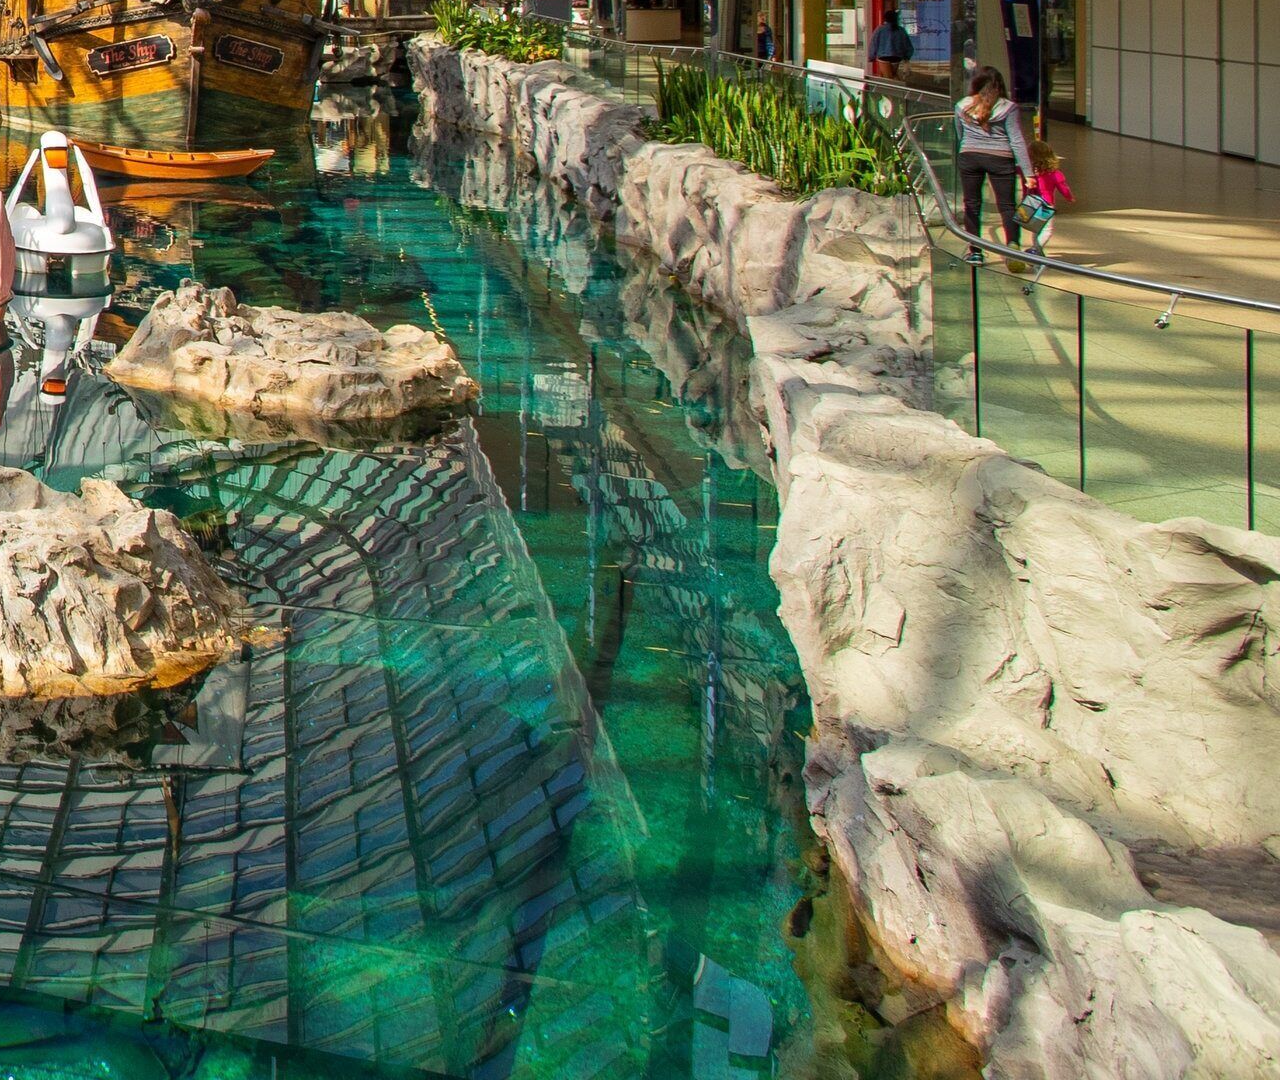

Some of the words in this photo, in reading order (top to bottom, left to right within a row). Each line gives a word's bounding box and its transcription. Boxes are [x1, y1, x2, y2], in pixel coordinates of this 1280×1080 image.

[100, 48, 125, 66] The
[128, 39, 159, 61] Ship
[228, 39, 248, 56] The
[247, 47, 274, 68] Ship
